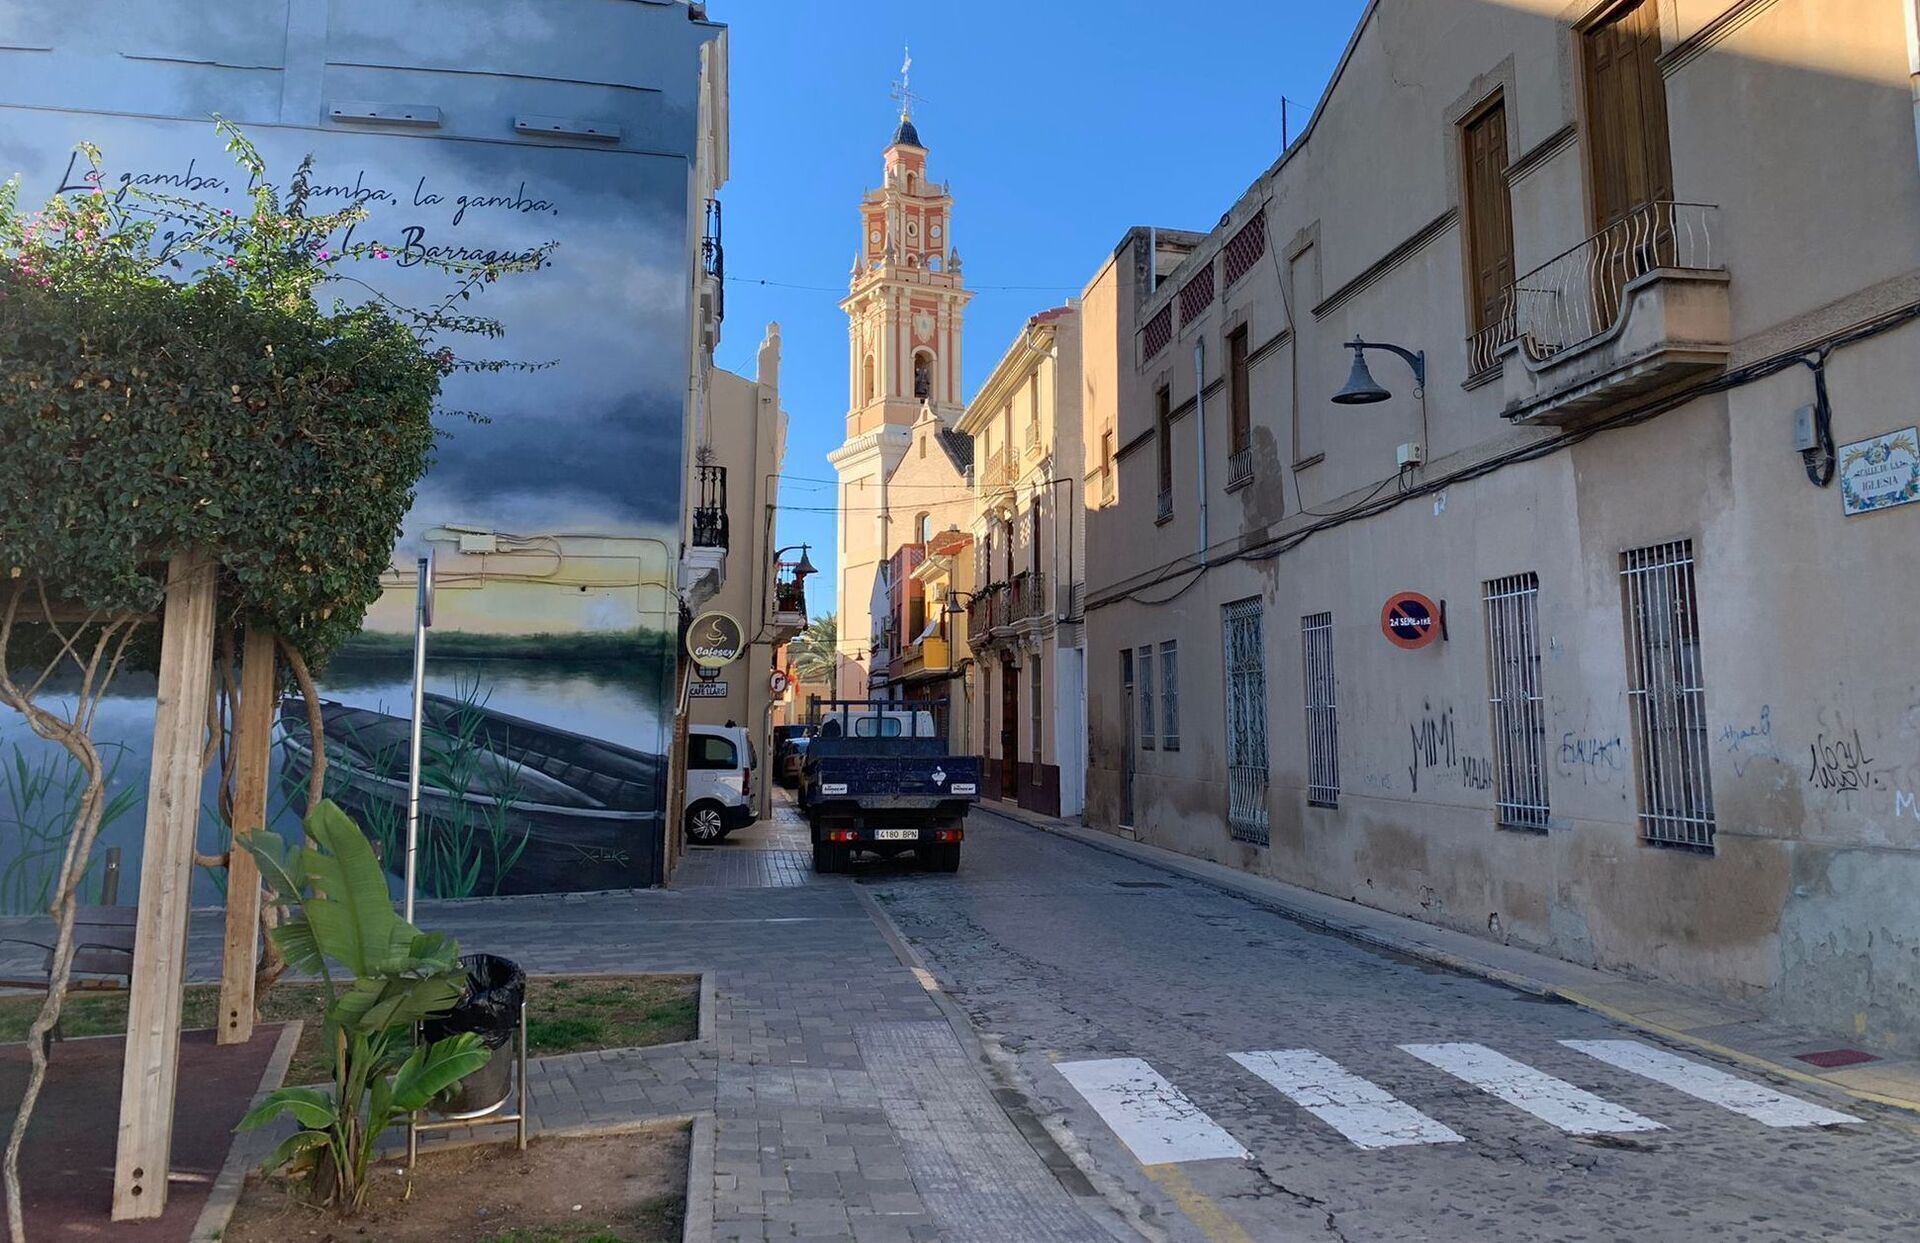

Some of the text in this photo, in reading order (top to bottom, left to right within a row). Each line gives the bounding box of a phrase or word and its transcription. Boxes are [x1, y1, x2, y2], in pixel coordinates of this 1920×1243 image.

[115, 158, 230, 204] gamba,
[304, 170, 397, 205] amba,
[413, 176, 446, 206] la
[452, 181, 559, 226] gamba,
[1862, 475, 1899, 492] IGLESIA
